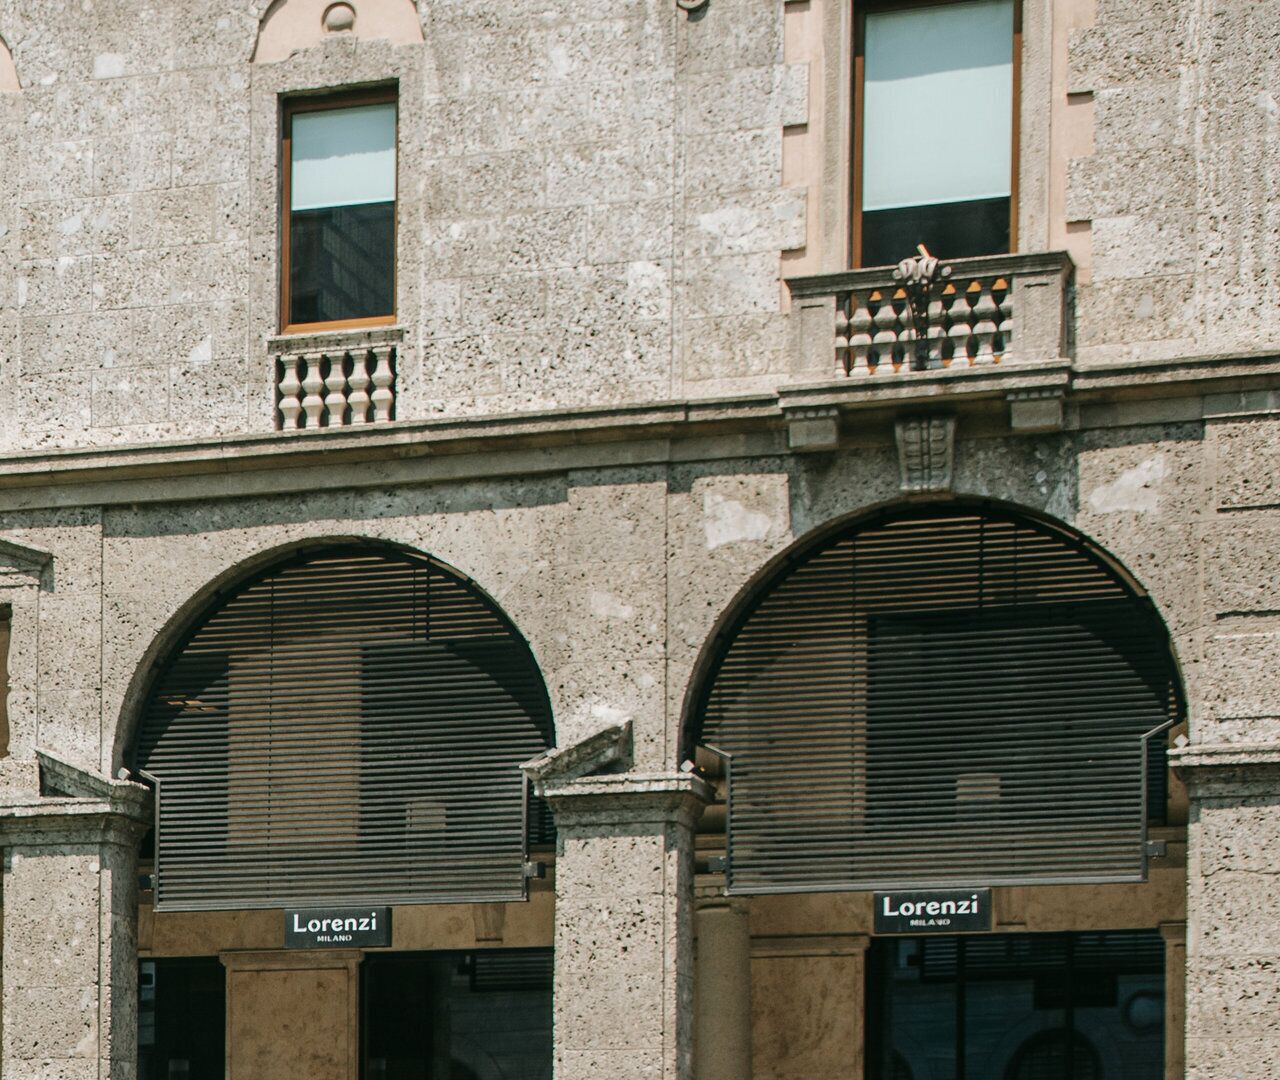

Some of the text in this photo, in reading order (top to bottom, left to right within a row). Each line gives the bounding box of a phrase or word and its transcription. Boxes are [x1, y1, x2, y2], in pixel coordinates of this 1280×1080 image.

[883, 894, 978, 916] Lorenzi
[293, 912, 376, 933] Lorenzi
[909, 918, 951, 927] MILANO
[316, 934, 352, 943] MILANO
